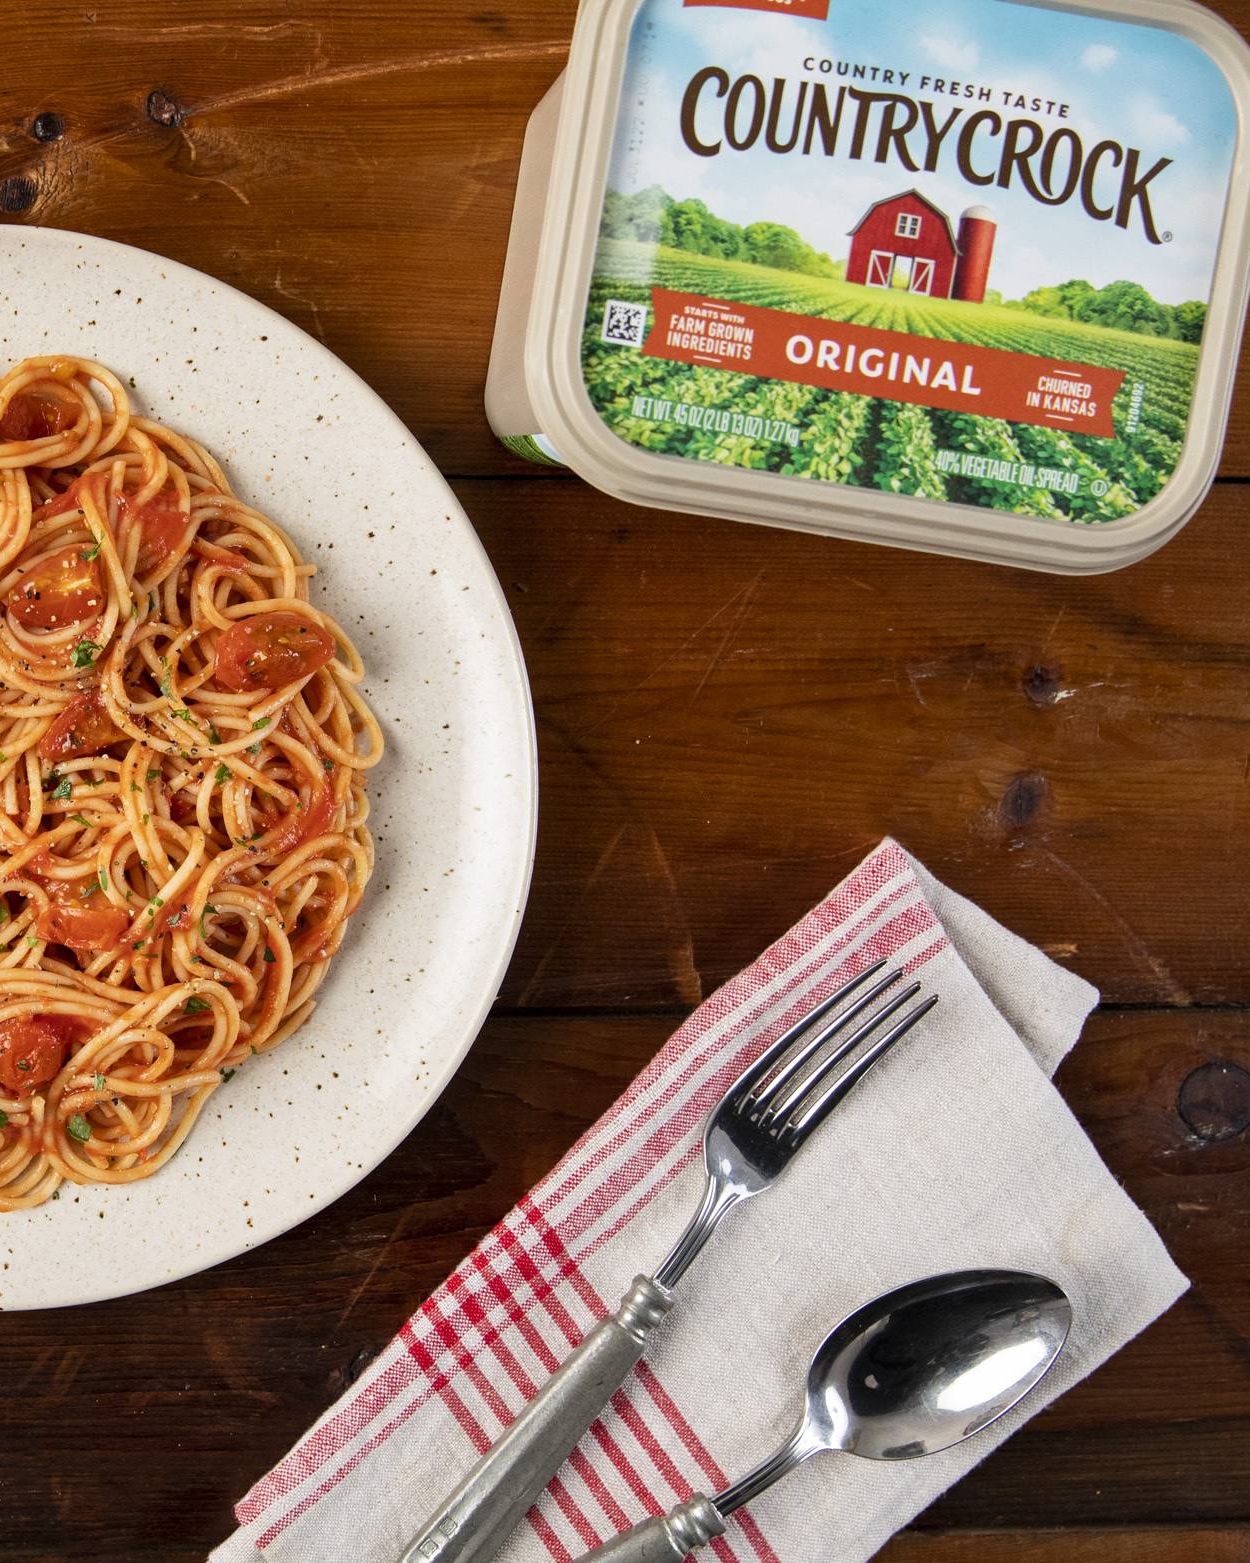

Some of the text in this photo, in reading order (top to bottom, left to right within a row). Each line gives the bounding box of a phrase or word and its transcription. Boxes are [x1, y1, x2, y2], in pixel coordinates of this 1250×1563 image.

[803, 57, 1070, 119] COUNTRY FRESH TASTE
[670, 314, 754, 344] FARM GROWN
[684, 305, 746, 324] STARTS WITH
[666, 330, 752, 360] INGREDIENTS
[785, 334, 981, 395] ORIGINAL
[1037, 376, 1092, 399] CHURNED
[631, 395, 654, 418] NET
[673, 403, 689, 425] 45
[688, 405, 705, 428] OZ
[703, 408, 716, 431] (2
[715, 411, 730, 433] LB
[731, 413, 744, 435] 13
[743, 415, 763, 441] OZ)
[1026, 391, 1097, 417] IN KANSAS
[935, 450, 1080, 494] 40% VEGETABLE OIL SPREAD
